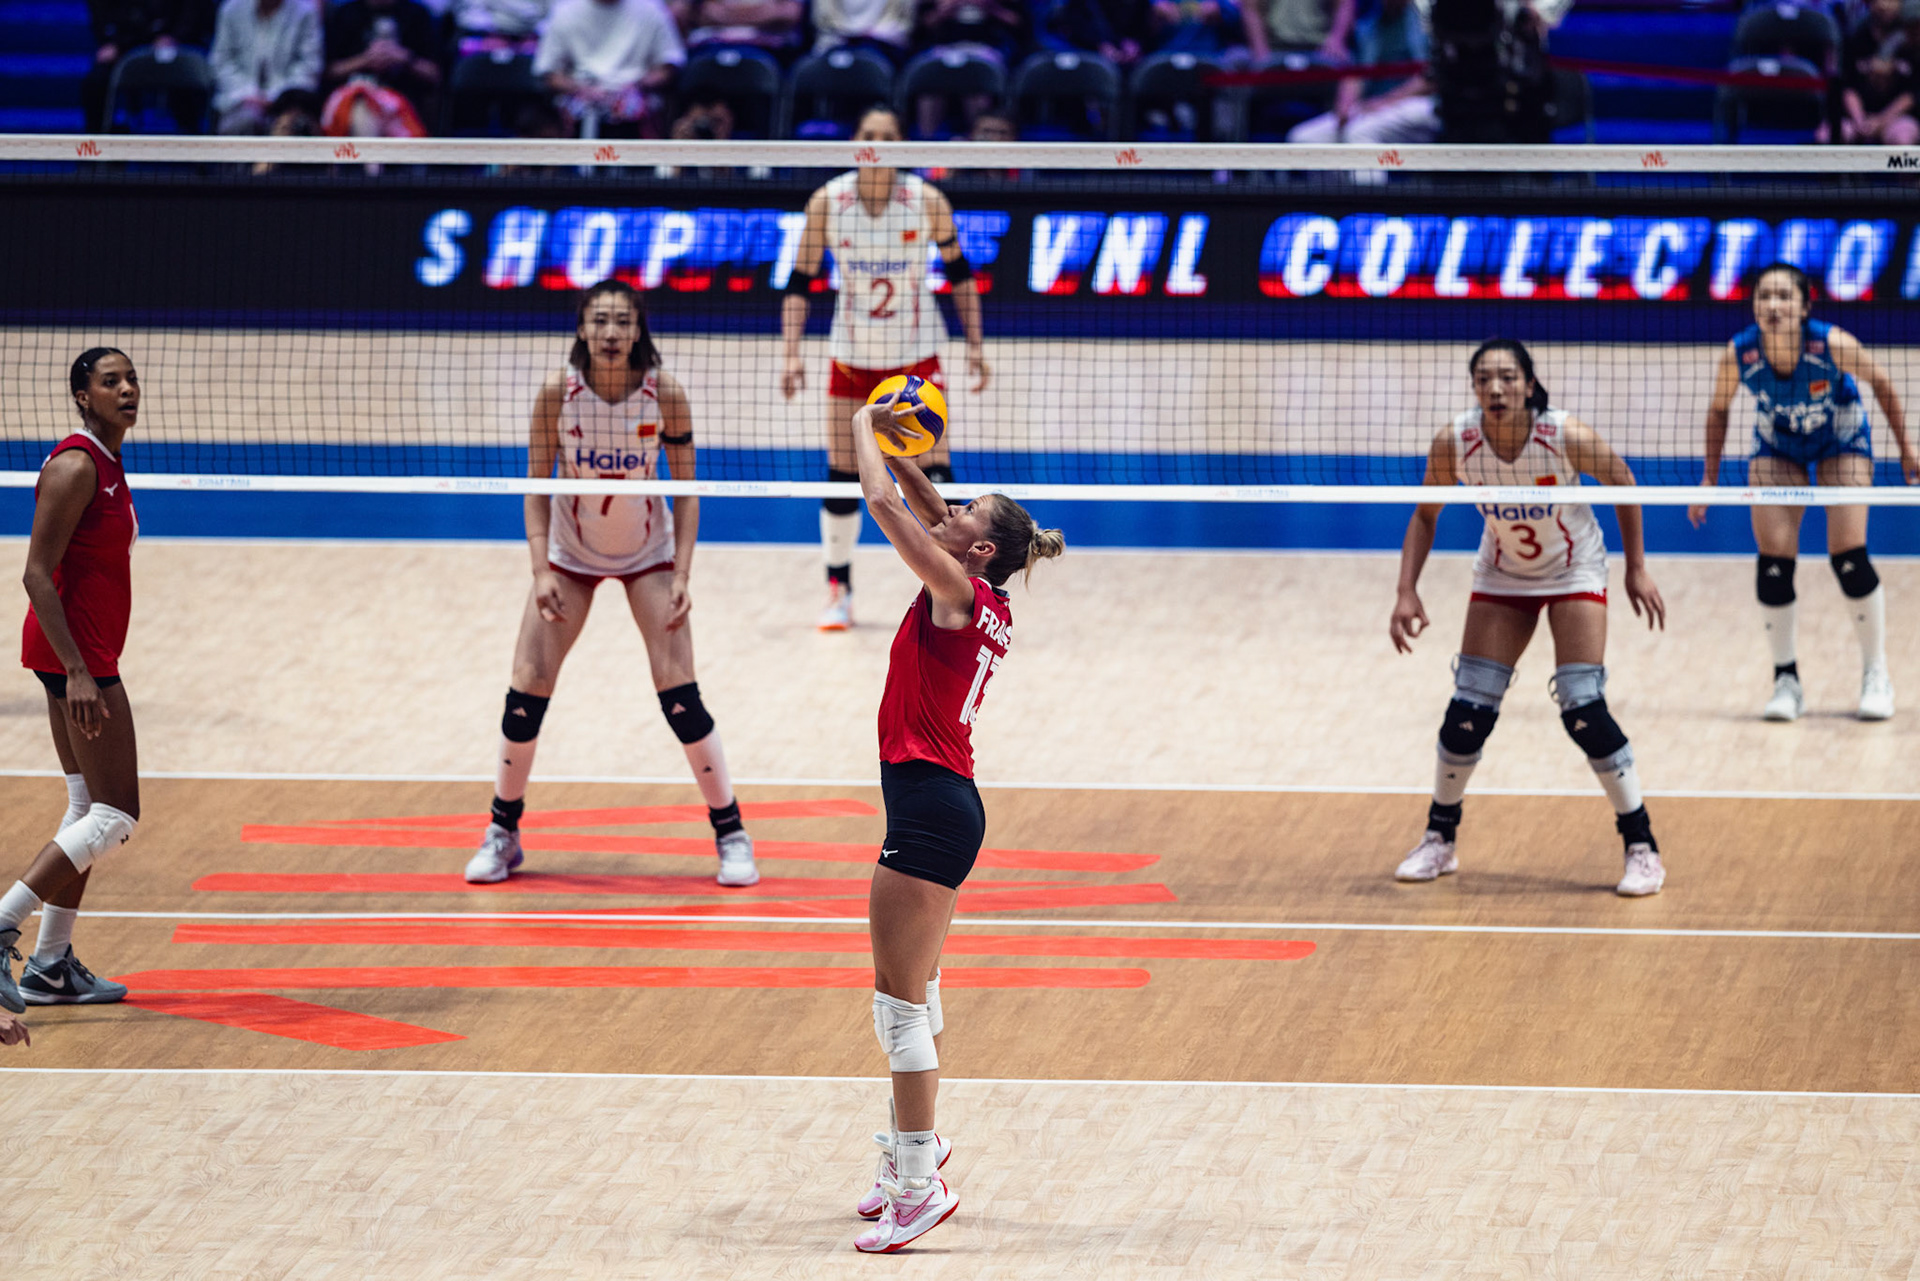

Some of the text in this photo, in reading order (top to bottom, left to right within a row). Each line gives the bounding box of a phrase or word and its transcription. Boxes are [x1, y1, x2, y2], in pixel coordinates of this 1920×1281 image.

[76, 140, 102, 157] VNL
[333, 142, 361, 159] VNL
[594, 144, 621, 162] VNL
[854, 146, 881, 163] VNL
[1115, 148, 1143, 165] VNL
[1377, 149, 1404, 166] VNL
[1641, 150, 1668, 168] VNL
[415, 207, 696, 289] SHOP
[1029, 212, 1209, 294] VNL
[868, 278, 896, 319] 2
[576, 449, 648, 470] Haier
[599, 473, 627, 517] 7
[1482, 503, 1554, 521] Haier
[1510, 523, 1543, 561] 3
